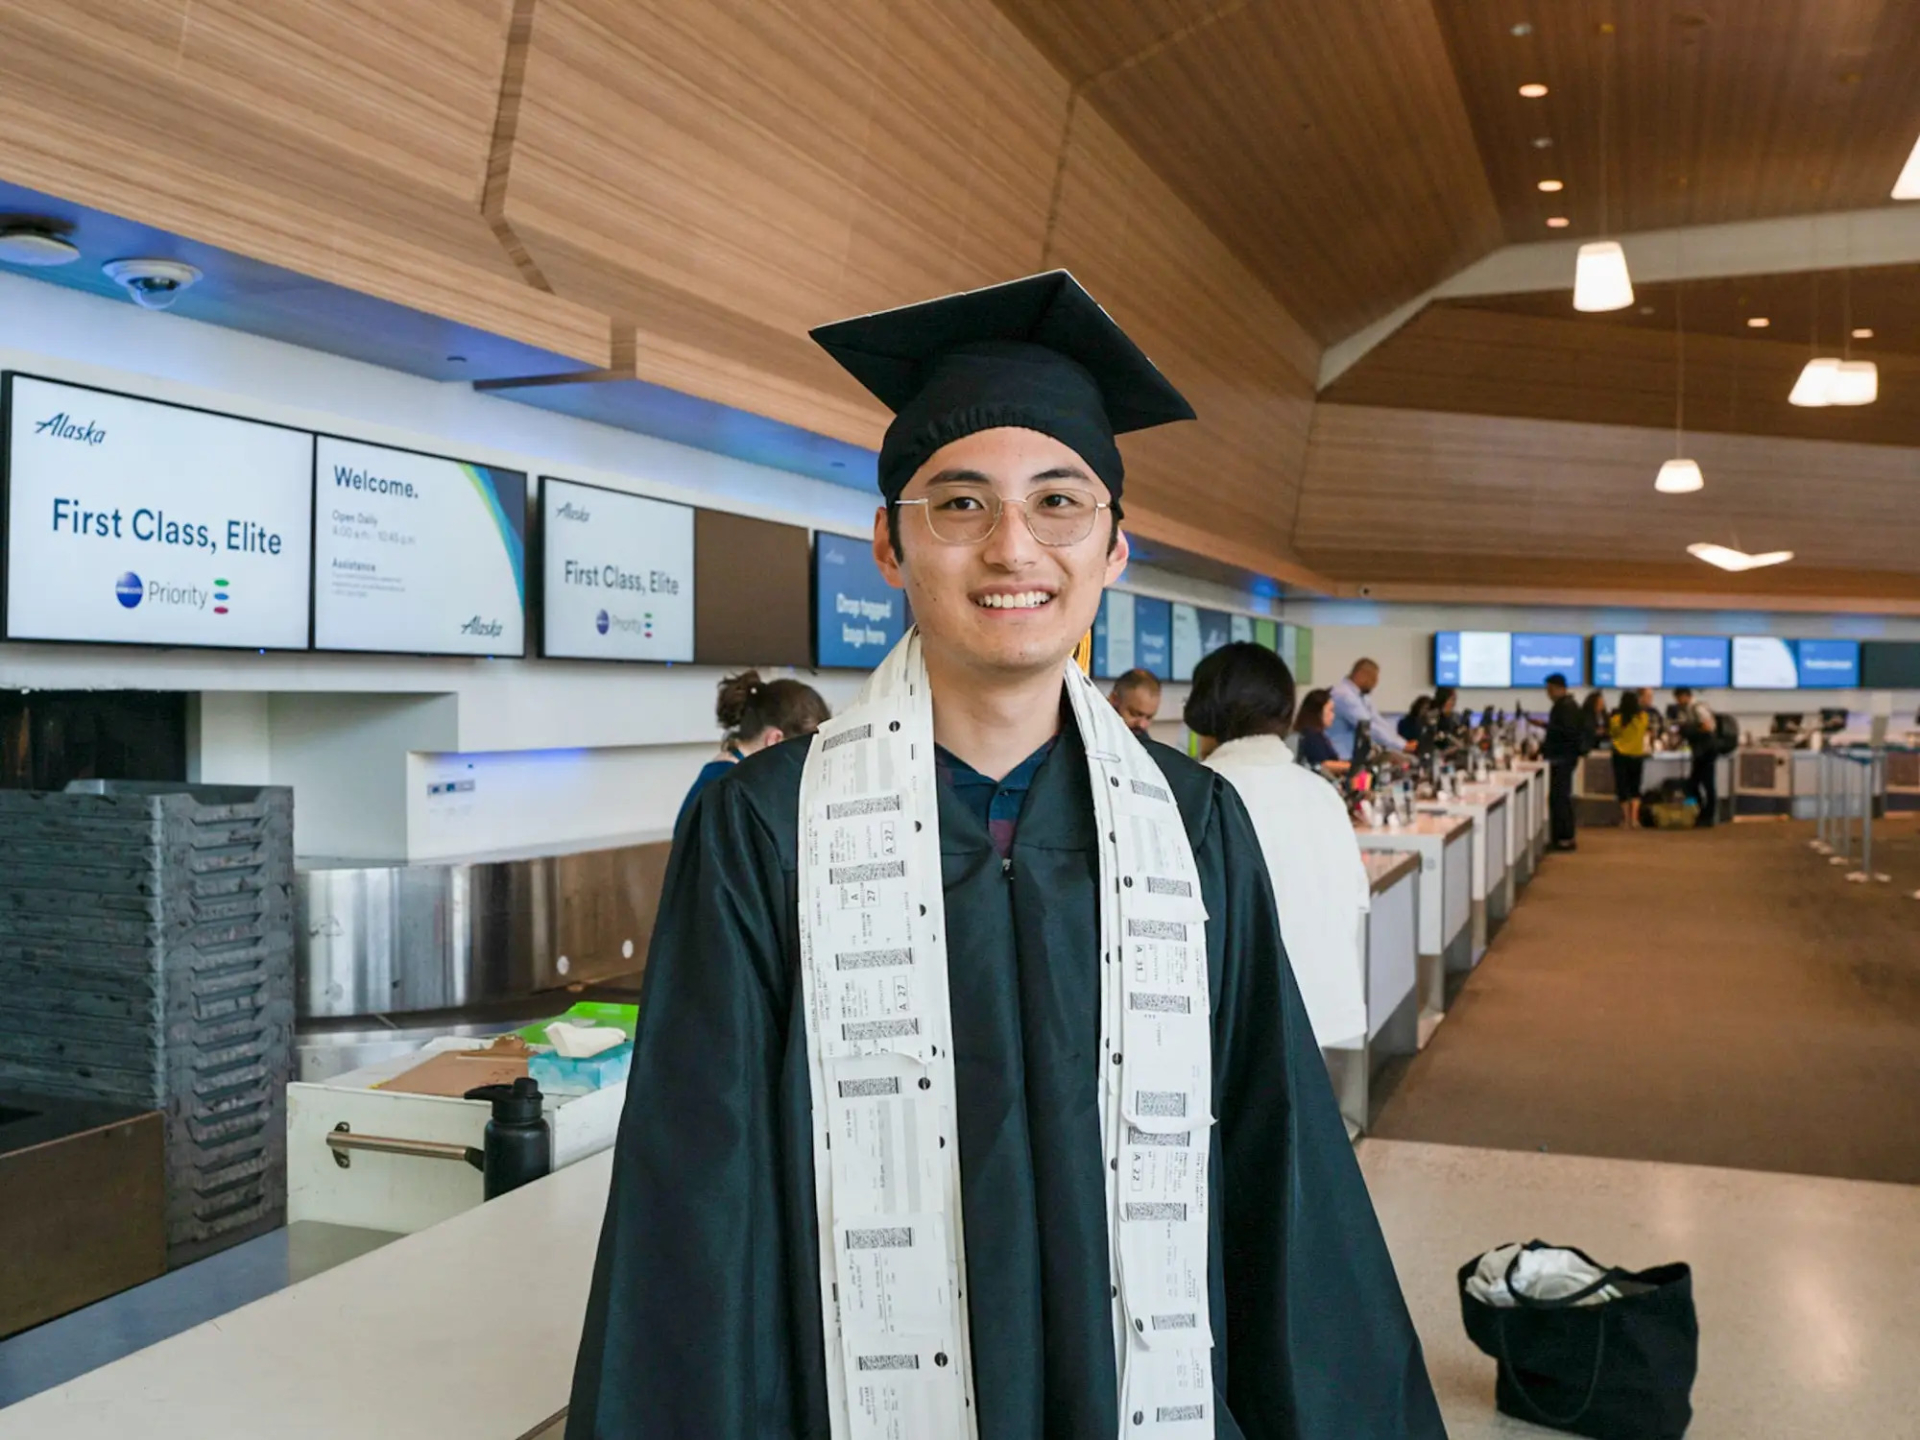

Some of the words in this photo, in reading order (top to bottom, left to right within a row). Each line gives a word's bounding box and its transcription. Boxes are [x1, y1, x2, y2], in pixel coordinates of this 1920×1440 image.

[35, 412, 106, 446] Alaska
[333, 464, 419, 499] Welcome.
[52, 497, 122, 539] First
[132, 507, 217, 555] Class,
[226, 520, 283, 556] Elite
[555, 501, 591, 523] Alaska
[564, 559, 599, 588] First
[603, 565, 645, 596] Class,
[650, 570, 680, 595] Elite
[148, 580, 208, 610] Priority
[866, 890, 876, 902] 27
[897, 984, 907, 997] 27
